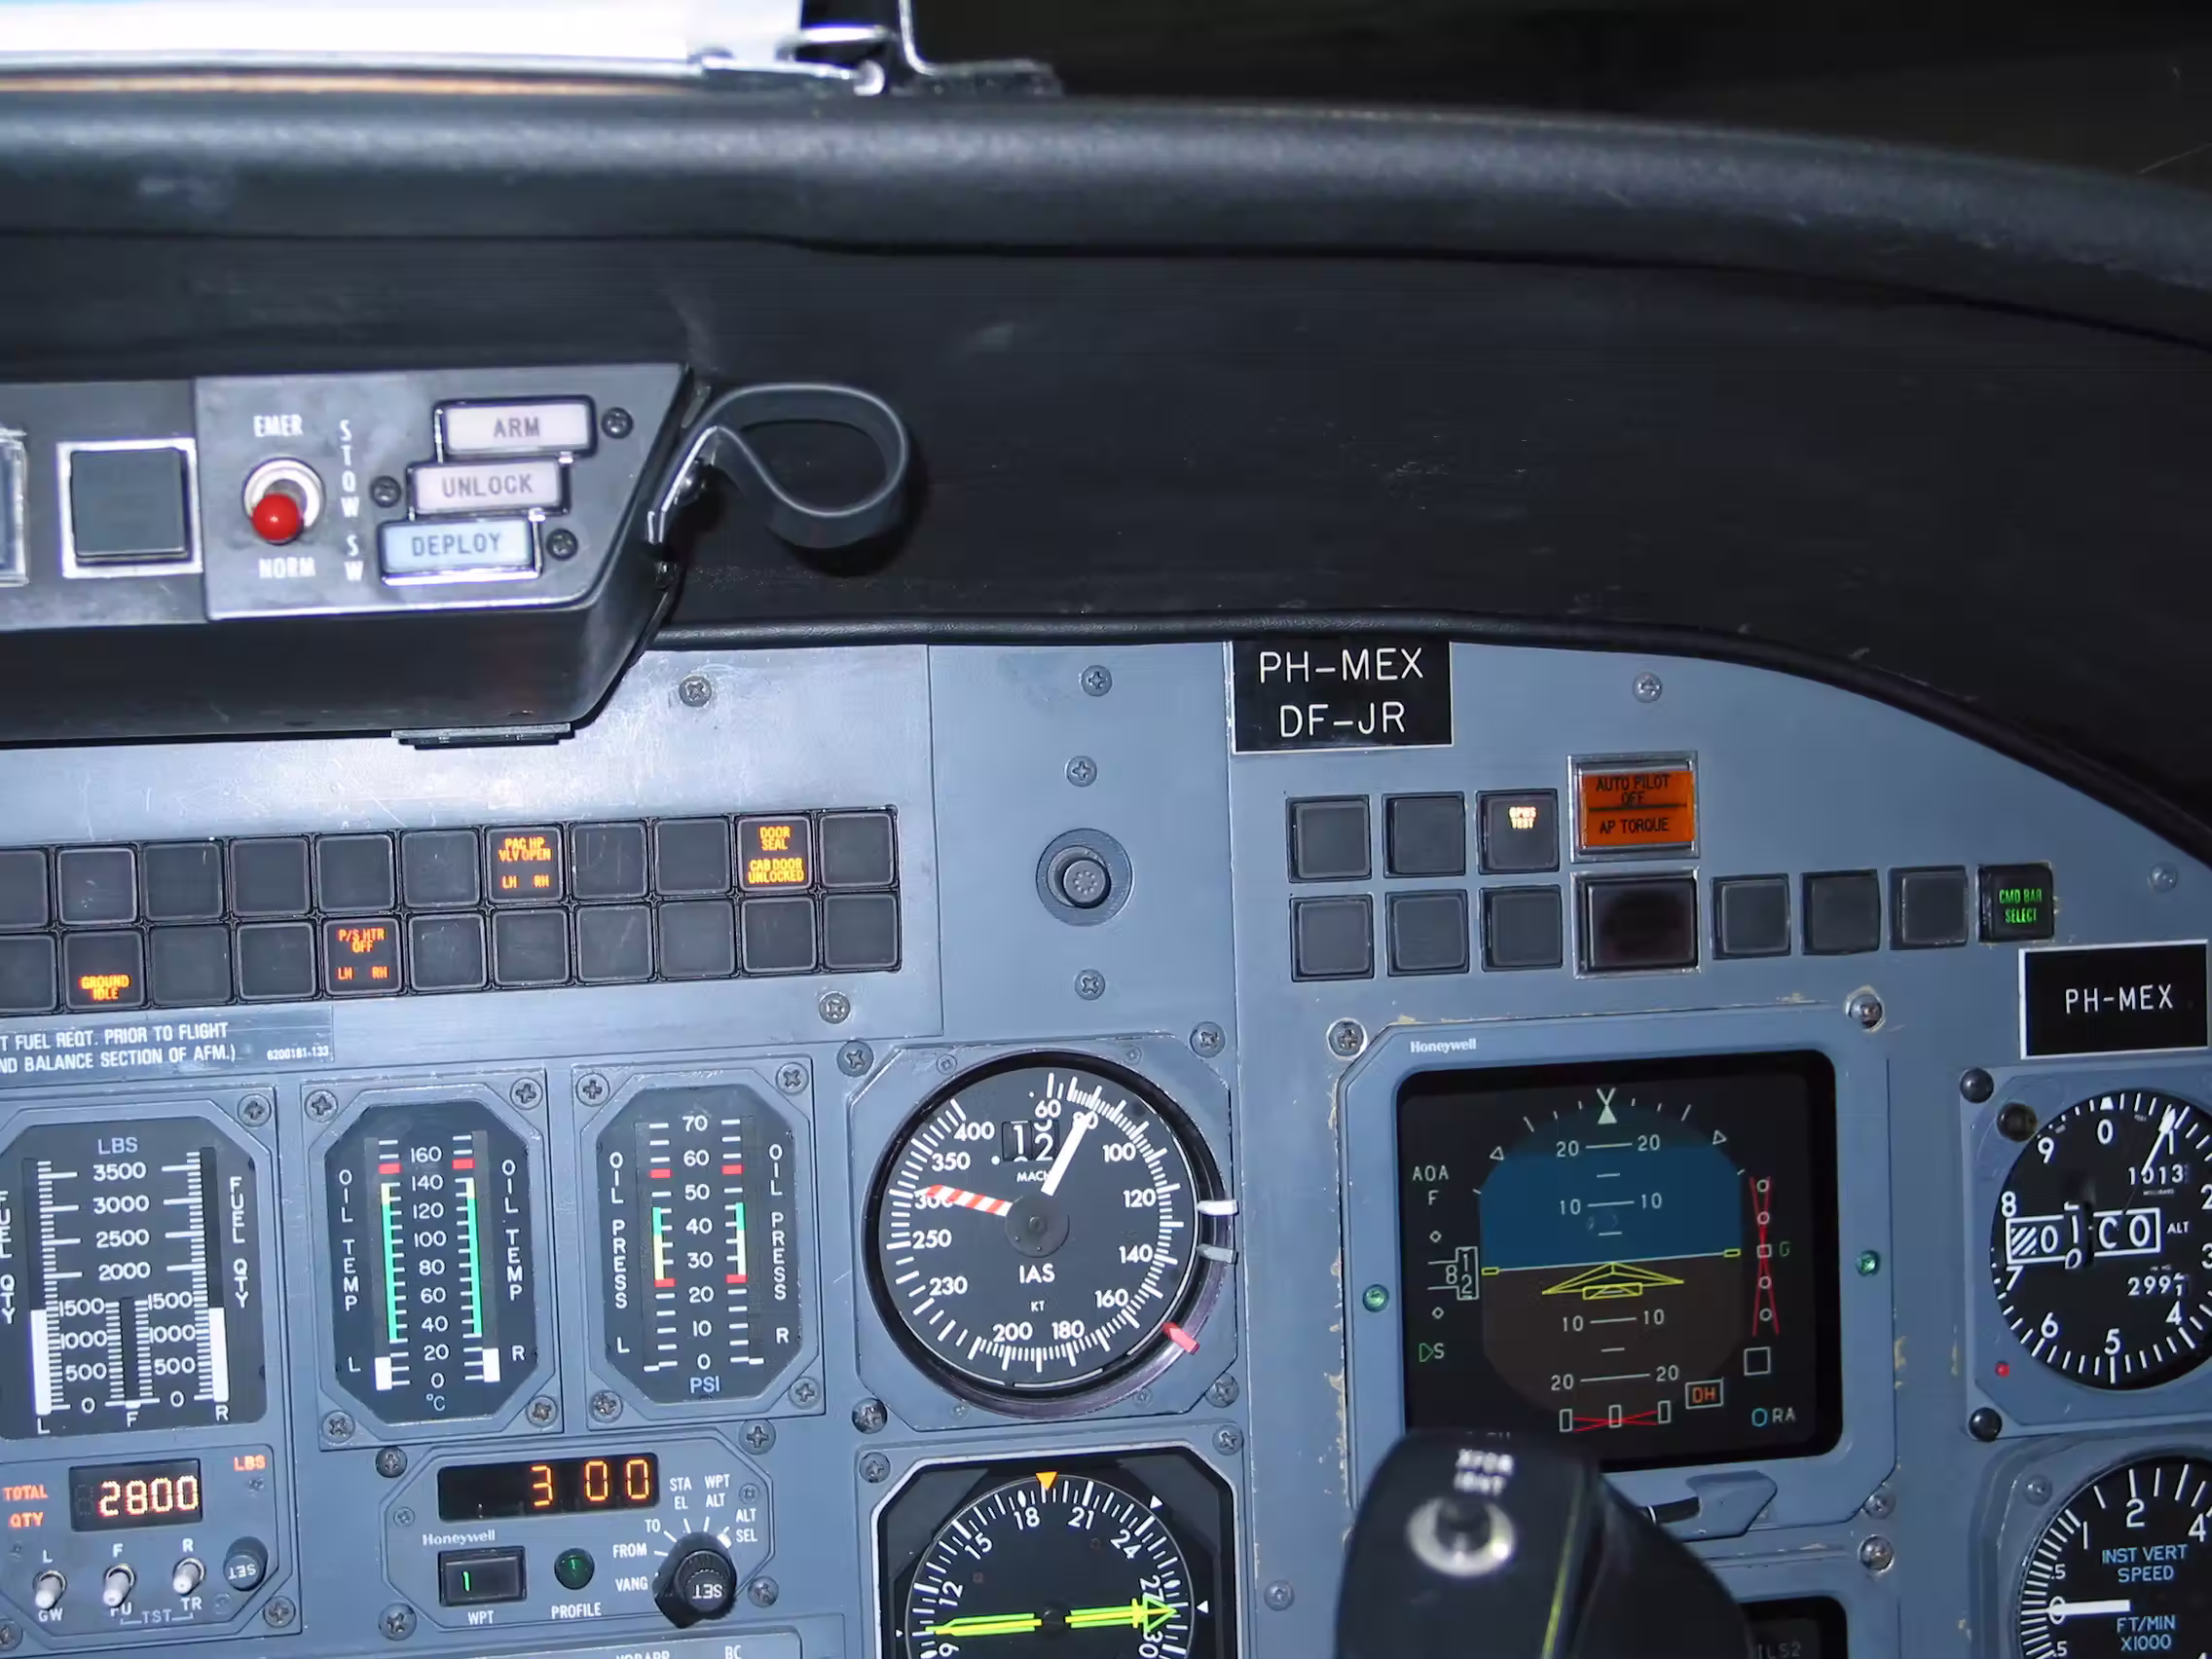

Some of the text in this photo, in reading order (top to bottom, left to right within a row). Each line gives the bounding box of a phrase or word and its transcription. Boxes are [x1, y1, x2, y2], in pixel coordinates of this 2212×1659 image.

[254, 415, 303, 437] EMER
[493, 416, 541, 439] ARM
[441, 473, 535, 498] UNLOCK
[412, 532, 502, 557] DEPLOY
[259, 557, 315, 579] NORM
[1259, 646, 1424, 683] PH-MEX
[1279, 701, 1406, 738] DF-JR
[1597, 773, 1671, 792] AUTO PILOT
[1620, 791, 1645, 805] OFF
[759, 826, 791, 838] DOOR
[1600, 817, 1670, 834] AP TORQUE
[761, 838, 789, 850] SEAL
[772, 858, 802, 871] DOOR
[501, 875, 518, 888] LH
[748, 869, 805, 883] UNLOCKED
[2005, 907, 2038, 924] SELECT
[362, 927, 386, 940] HTR
[352, 940, 374, 952] OFF
[81, 975, 129, 989] GROUND
[338, 967, 353, 980] LH
[2065, 982, 2175, 1015] PH-MEX
[16, 1021, 229, 1051] FUEL REQT. PRIOR TO FLIGHT
[1410, 1038, 1477, 1053] Honeywell
[24, 1052, 94, 1072] BALANCE
[101, 1049, 163, 1068] SECTION
[168, 1047, 187, 1063] OF
[1035, 1100, 1062, 1119] 60
[682, 1116, 709, 1132] 70
[953, 1122, 996, 1142] 400
[97, 1137, 138, 1156] LBS
[410, 1146, 442, 1163] 160
[1102, 1143, 1137, 1162] 100
[1557, 1134, 1660, 1157] 20 20
[2038, 1137, 2055, 1163] 9
[682, 1149, 710, 1166] 60
[931, 1152, 972, 1171] 350
[92, 1161, 147, 1182] 3500
[1413, 1164, 1449, 1182] AOA
[411, 1174, 444, 1191] 140
[684, 1184, 711, 1200] 50
[1123, 1189, 1157, 1208] 120
[92, 1195, 150, 1215] 3000
[413, 1202, 445, 1219] 120
[1560, 1193, 1662, 1215] 10 10
[2001, 1191, 2017, 1217] 8
[685, 1217, 713, 1235] 40
[2166, 1221, 2189, 1235] ALT
[95, 1229, 150, 1249] 2500
[414, 1231, 447, 1247] 100
[912, 1230, 952, 1249] 250
[687, 1252, 714, 1269] 30
[1119, 1244, 1154, 1264] 140
[98, 1262, 151, 1281] 2000
[419, 1259, 445, 1275] 80
[1018, 1264, 1055, 1285] IAS
[688, 1286, 715, 1303] 20
[929, 1276, 969, 1296] 230
[58, 1291, 194, 1316] 1500 1500
[420, 1287, 446, 1304] 60
[1095, 1288, 1128, 1309] 160
[1030, 1300, 1046, 1312] KT
[421, 1315, 449, 1332] 40
[692, 1320, 713, 1337] 10
[1051, 1319, 1086, 1340] 180
[1563, 1309, 1665, 1332] 10 10
[2041, 1311, 2059, 1339] 6
[59, 1324, 196, 1348] 1000 1000
[992, 1321, 1033, 1342] 200
[2104, 1329, 2121, 1354] 5
[424, 1344, 449, 1361] 20
[65, 1356, 196, 1382] 500 500
[1551, 1365, 1679, 1390] 20 20
[689, 1376, 720, 1393] PSI
[1692, 1386, 1716, 1403] DH
[1772, 1407, 1796, 1422] RA
[233, 1455, 267, 1471] LBS
[670, 1477, 692, 1492] STA
[704, 1474, 730, 1489] WPT
[3, 1485, 49, 1500] TOTAL
[98, 1475, 200, 1517] 2800
[705, 1493, 725, 1508] ALT
[675, 1495, 687, 1510] EL
[9, 1511, 45, 1528] QTY
[735, 1508, 756, 1522] ALT
[1014, 1507, 1041, 1530] 18
[1068, 1507, 1094, 1530] 21
[2125, 1497, 2146, 1528] 2
[645, 1519, 661, 1533] TO
[423, 1529, 496, 1547] Honeywell
[736, 1529, 758, 1543] SEL
[1110, 1529, 1142, 1560] 24
[613, 1543, 647, 1558] FROM
[965, 1532, 993, 1560] 15
[2102, 1544, 2188, 1564] INST VERT
[2118, 1565, 2174, 1583] SPEED
[615, 1577, 648, 1592] VANG
[939, 1580, 964, 1607] 12
[180, 1597, 203, 1611] TR
[551, 1603, 602, 1619] PROFILE
[38, 1607, 63, 1622] GW
[142, 1609, 172, 1624] TST
[467, 1610, 495, 1625] WPT
[2117, 1614, 2175, 1633] FT/MIN
[2120, 1634, 2171, 1651] X1000
